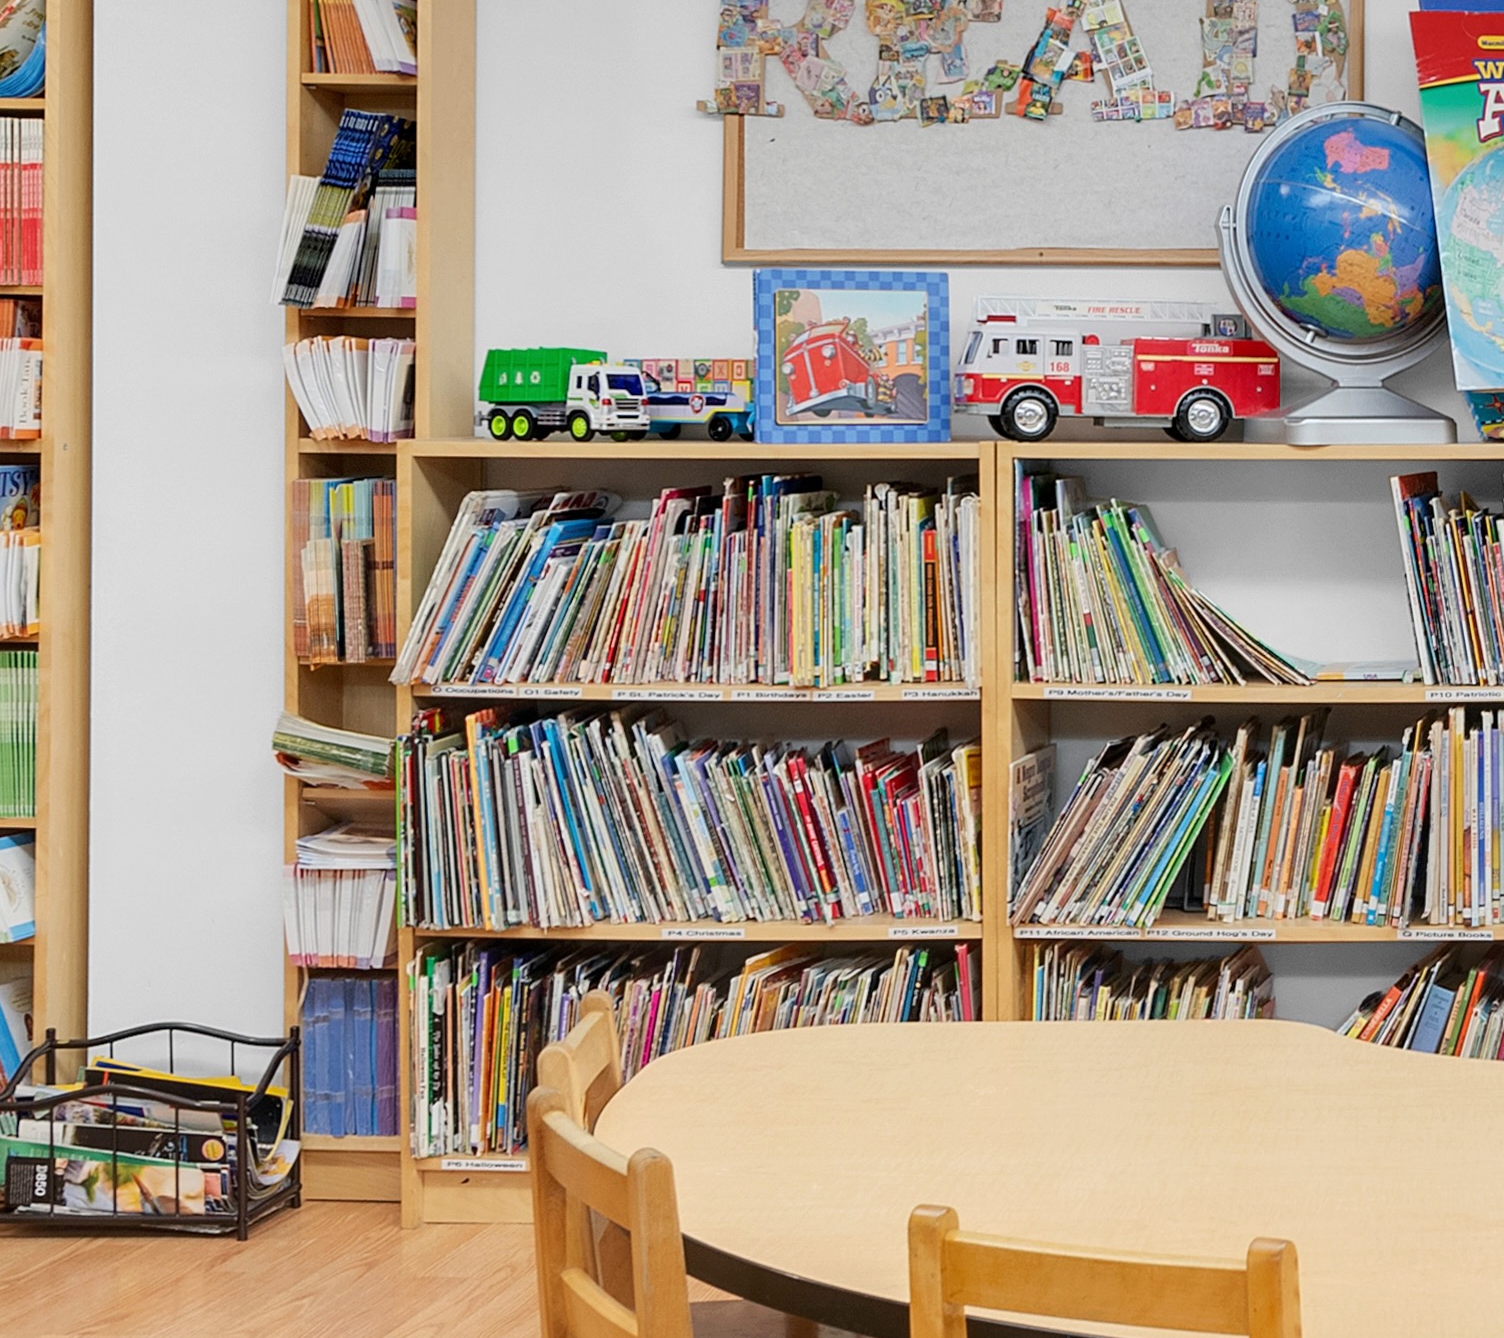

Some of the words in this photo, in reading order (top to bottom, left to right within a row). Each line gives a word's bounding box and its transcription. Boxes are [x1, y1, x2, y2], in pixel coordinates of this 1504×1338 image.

[1109, 306, 1141, 314] RESCUE
[1191, 343, 1231, 354] Tonka
[1050, 362, 1070, 372] 168
[1217, 930, 1248, 938] Hog's
[35, 1164, 48, 1197] D850
